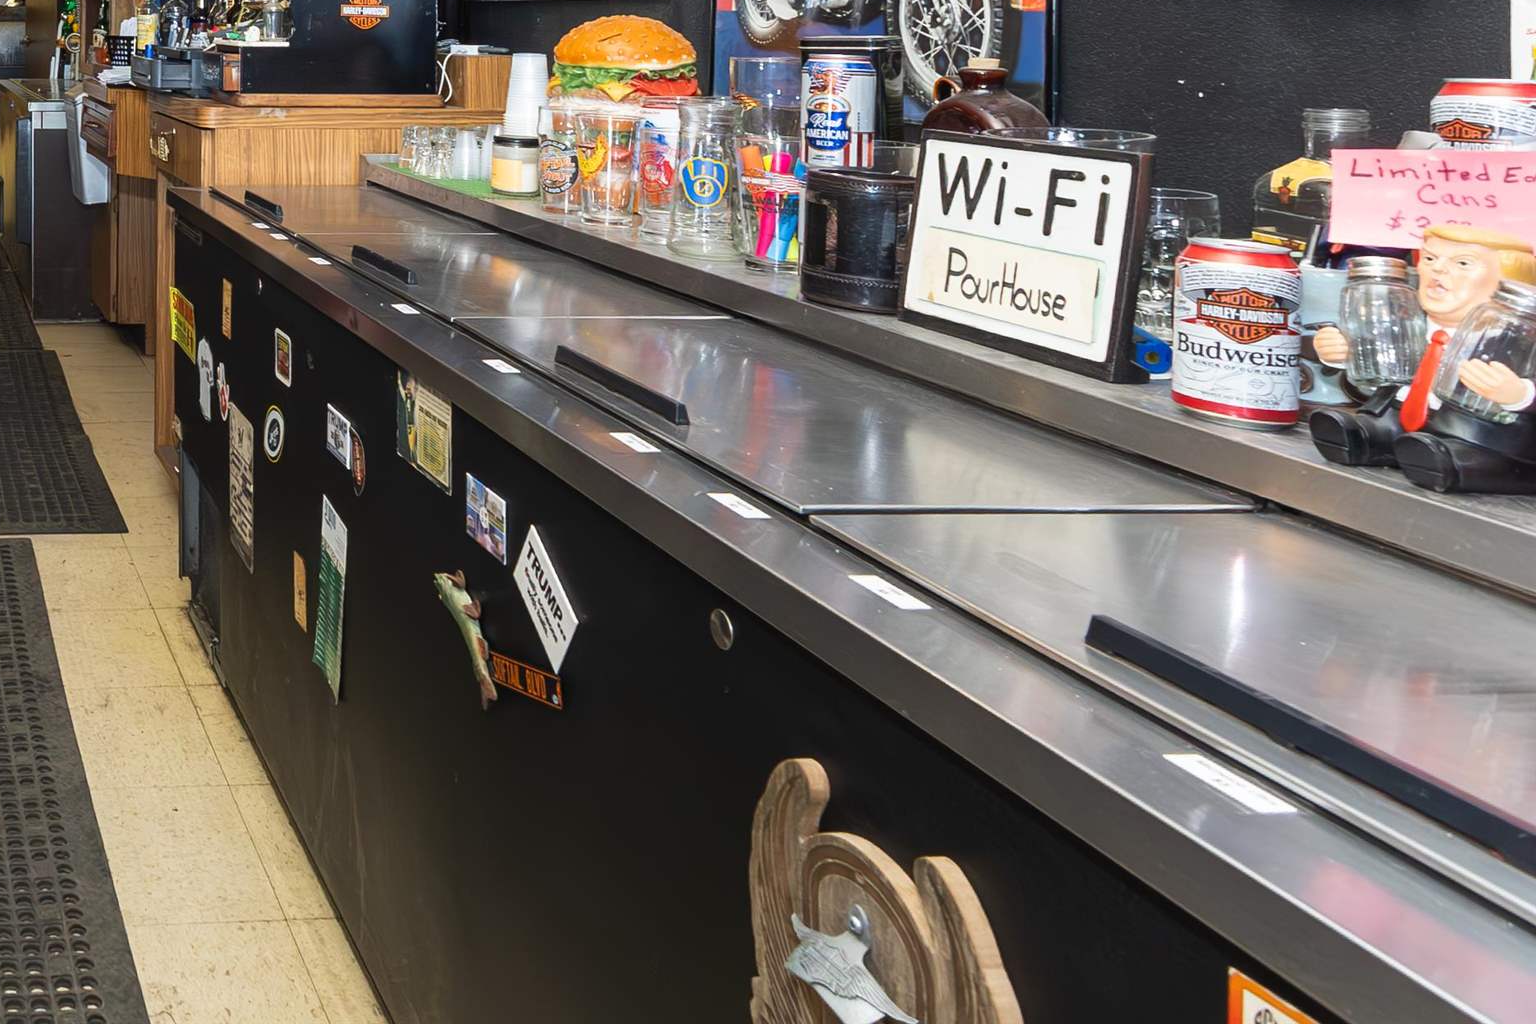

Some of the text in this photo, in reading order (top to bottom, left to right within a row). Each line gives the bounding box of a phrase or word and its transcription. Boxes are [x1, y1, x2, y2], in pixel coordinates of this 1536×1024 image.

[806, 128, 849, 141] AMERICAN
[1350, 158, 1490, 183] Limited
[938, 152, 1111, 246] Wi-Fi
[1417, 184, 1498, 208] Cans
[1220, 294, 1270, 308] MOTOR
[1201, 303, 1285, 325] HARLEY-DAVIDSON
[526, 667, 547, 700] BLVD
